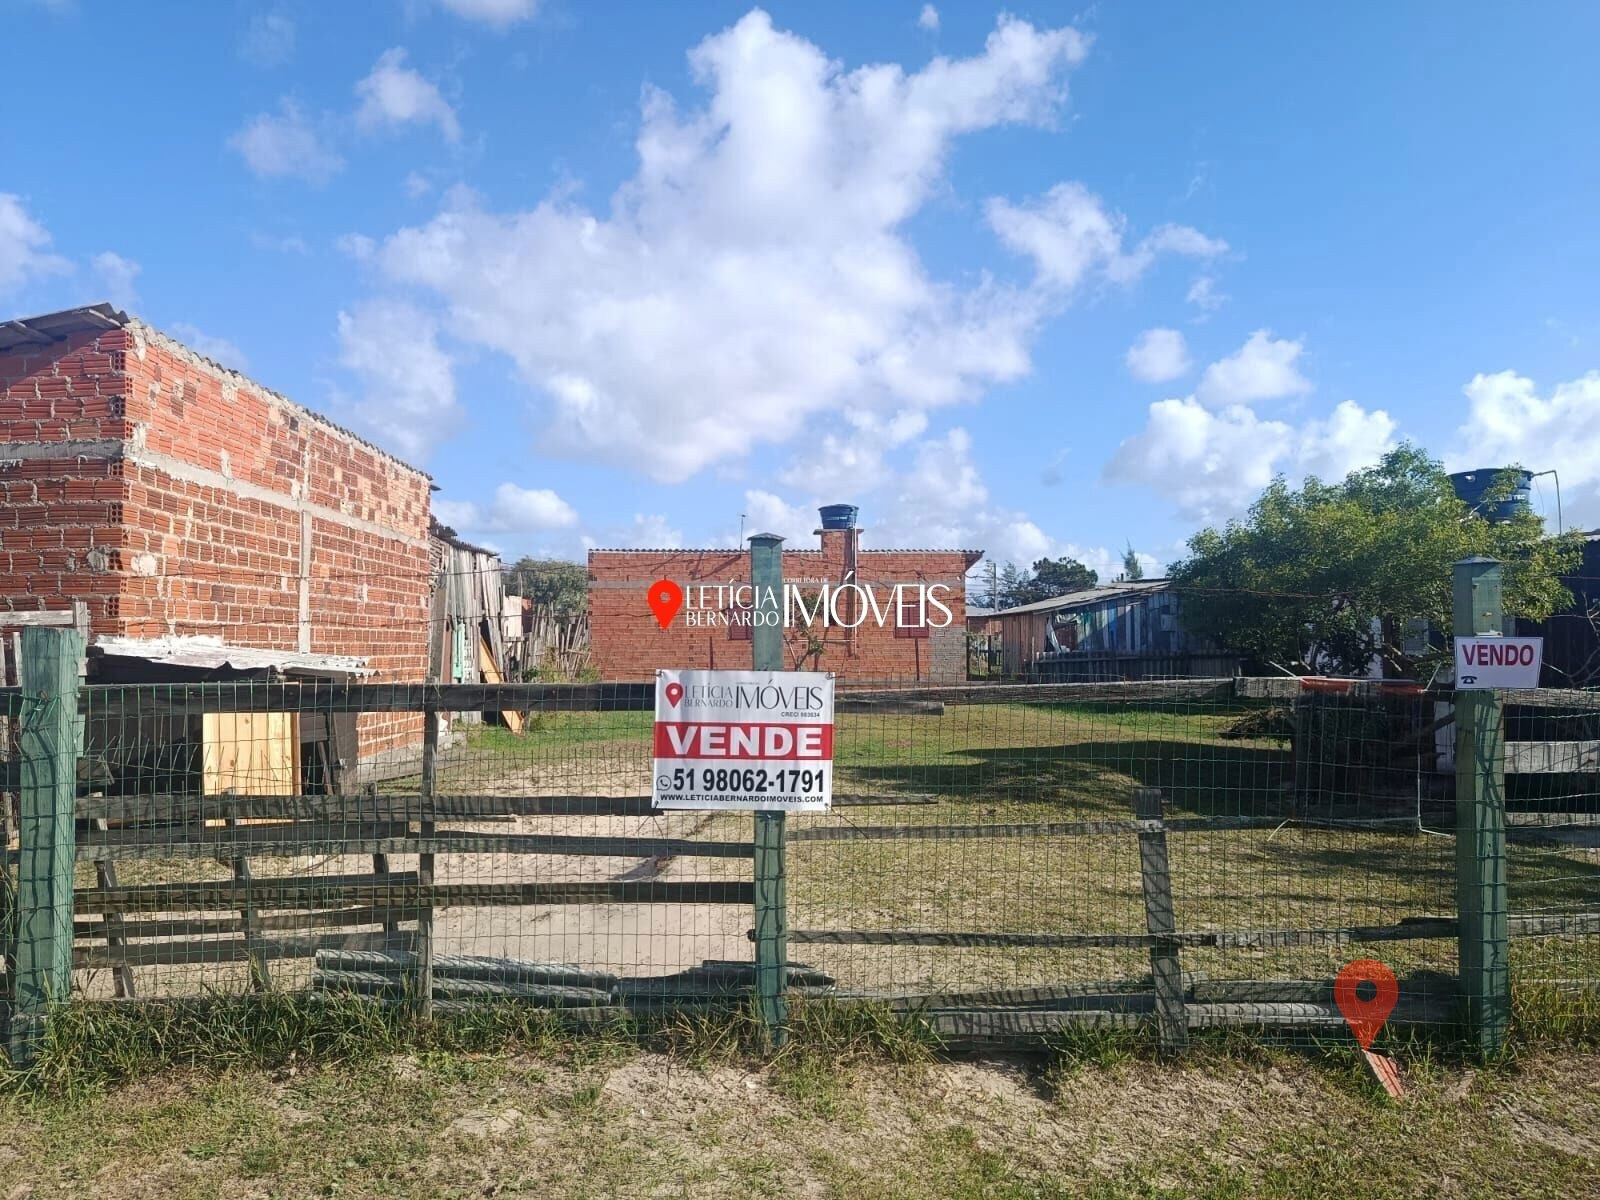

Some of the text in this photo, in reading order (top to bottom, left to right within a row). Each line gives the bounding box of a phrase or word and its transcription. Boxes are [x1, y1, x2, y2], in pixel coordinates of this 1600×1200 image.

[1462, 644, 1534, 666] VENDO
[684, 683, 733, 698] LETÍCIA
[736, 679, 823, 710] IMÓVEIS
[684, 699, 733, 708] BERNARDO
[665, 725, 823, 757] VENDE
[673, 768, 824, 793] 51 98062-1791
[660, 794, 824, 803] WWW.LETICIABERNARDOIMOVEIS.COM
